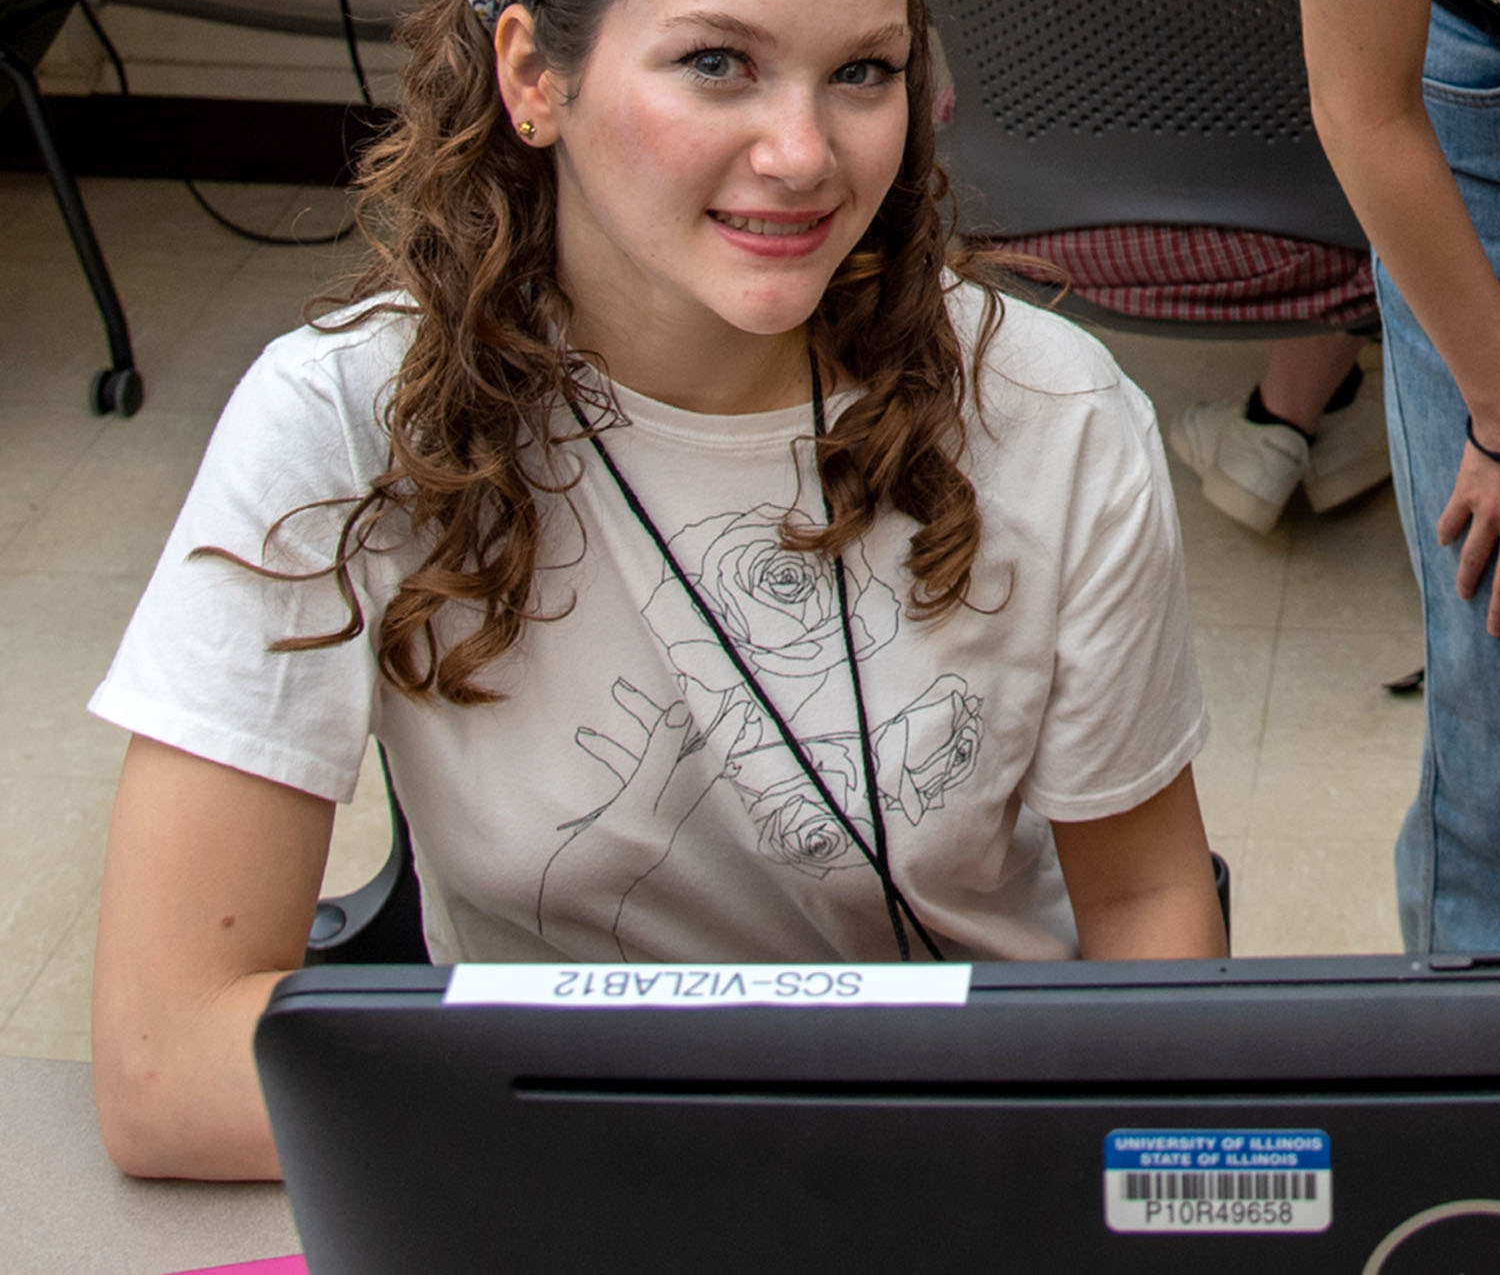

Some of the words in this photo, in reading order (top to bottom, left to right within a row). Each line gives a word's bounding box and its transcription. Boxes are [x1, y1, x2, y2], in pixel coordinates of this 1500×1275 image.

[553, 971, 863, 997] SCS-VIZLAB12
[1115, 1136, 1216, 1151] UNIVERSITY
[1220, 1136, 1244, 1150] OF
[1250, 1136, 1323, 1150] ILLINOIS
[1140, 1152, 1193, 1167] STATE
[1198, 1152, 1220, 1166] OF
[1226, 1152, 1298, 1166] ILLINOIS
[1145, 1200, 1293, 1225] P10R49658
